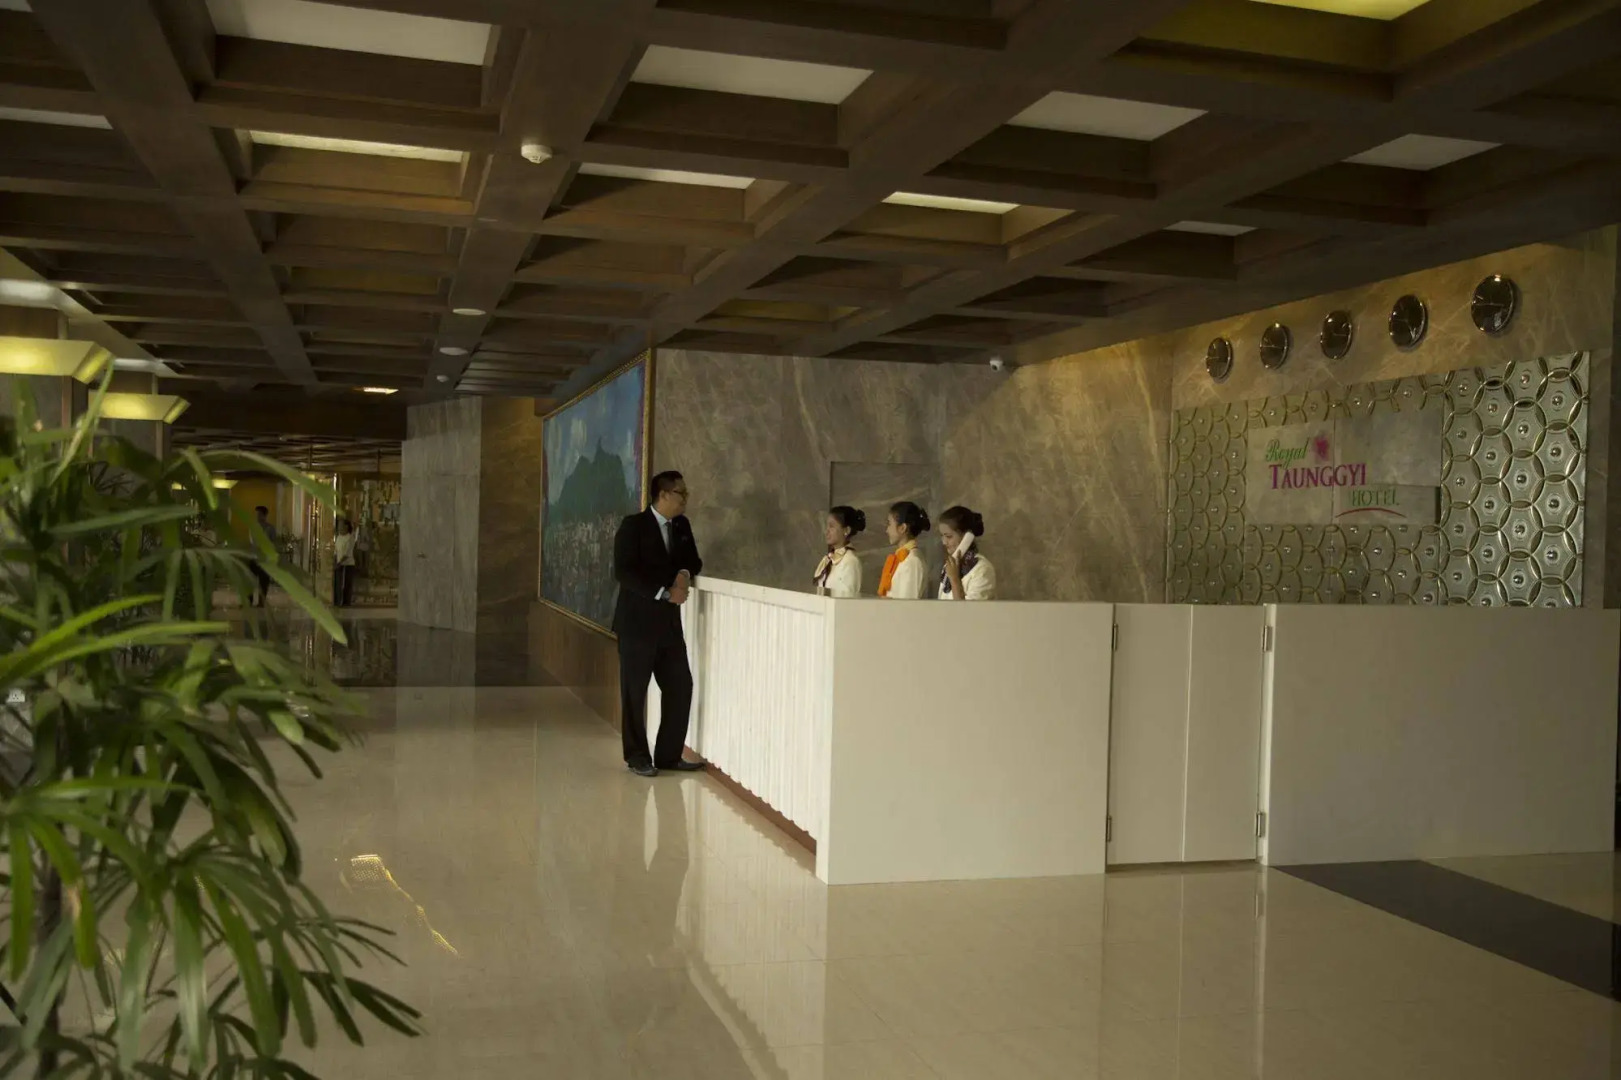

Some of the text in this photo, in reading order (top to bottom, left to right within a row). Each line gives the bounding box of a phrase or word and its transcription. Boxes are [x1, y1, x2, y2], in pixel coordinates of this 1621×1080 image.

[1265, 437, 1310, 468] Royal
[1269, 463, 1367, 490] TAUNGGYI
[1351, 488, 1400, 506] HOTEL
